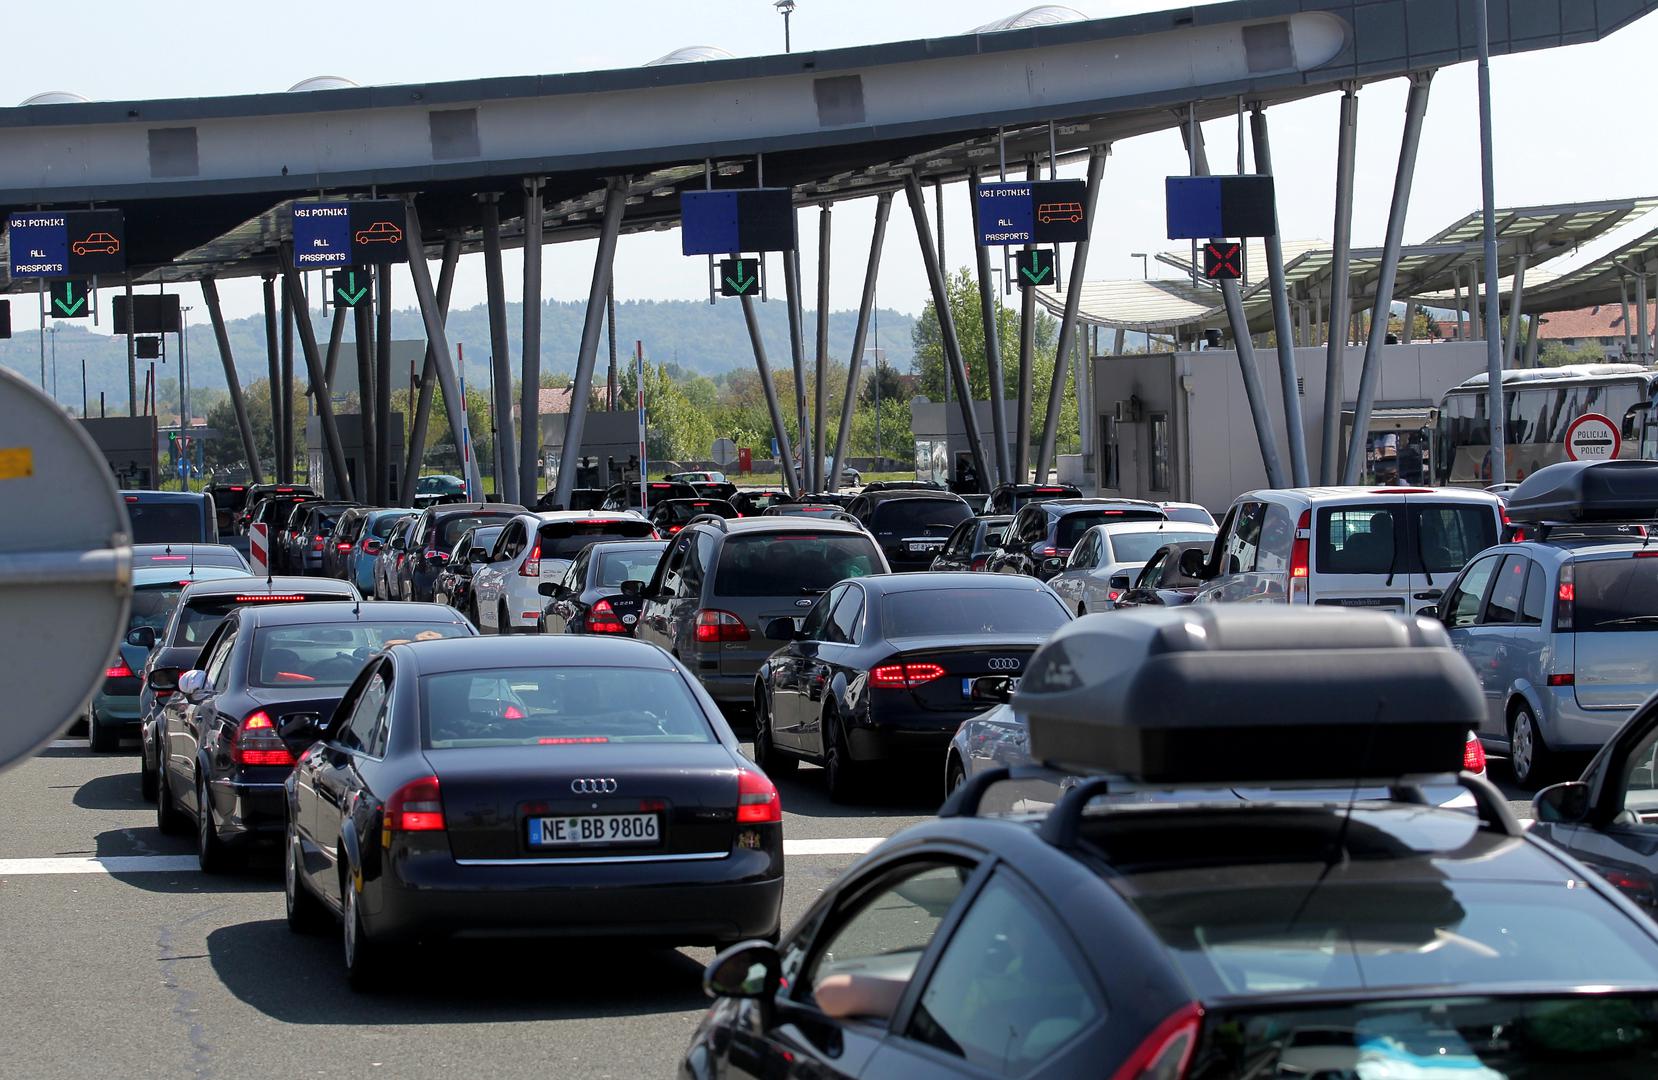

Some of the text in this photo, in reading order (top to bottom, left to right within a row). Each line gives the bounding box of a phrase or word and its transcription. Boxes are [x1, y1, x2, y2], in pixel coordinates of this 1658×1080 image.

[980, 189, 1030, 198] VSI POTNIKI
[294, 208, 348, 217] VSI POTNIKI
[11, 218, 65, 228] VSI POTNIKI
[998, 218, 1013, 226] ALL
[985, 232, 1029, 241] PASSPORTS
[313, 239, 330, 247] ALL
[30, 249, 47, 258] ALL
[299, 253, 346, 262] PASSPORTS
[16, 263, 63, 273] PASSPORTS
[1577, 430, 1608, 439] POLICIJA
[1580, 446, 1605, 455] POLICE
[542, 819, 567, 841] NE
[580, 818, 605, 840] BB
[609, 816, 656, 839] 9806
